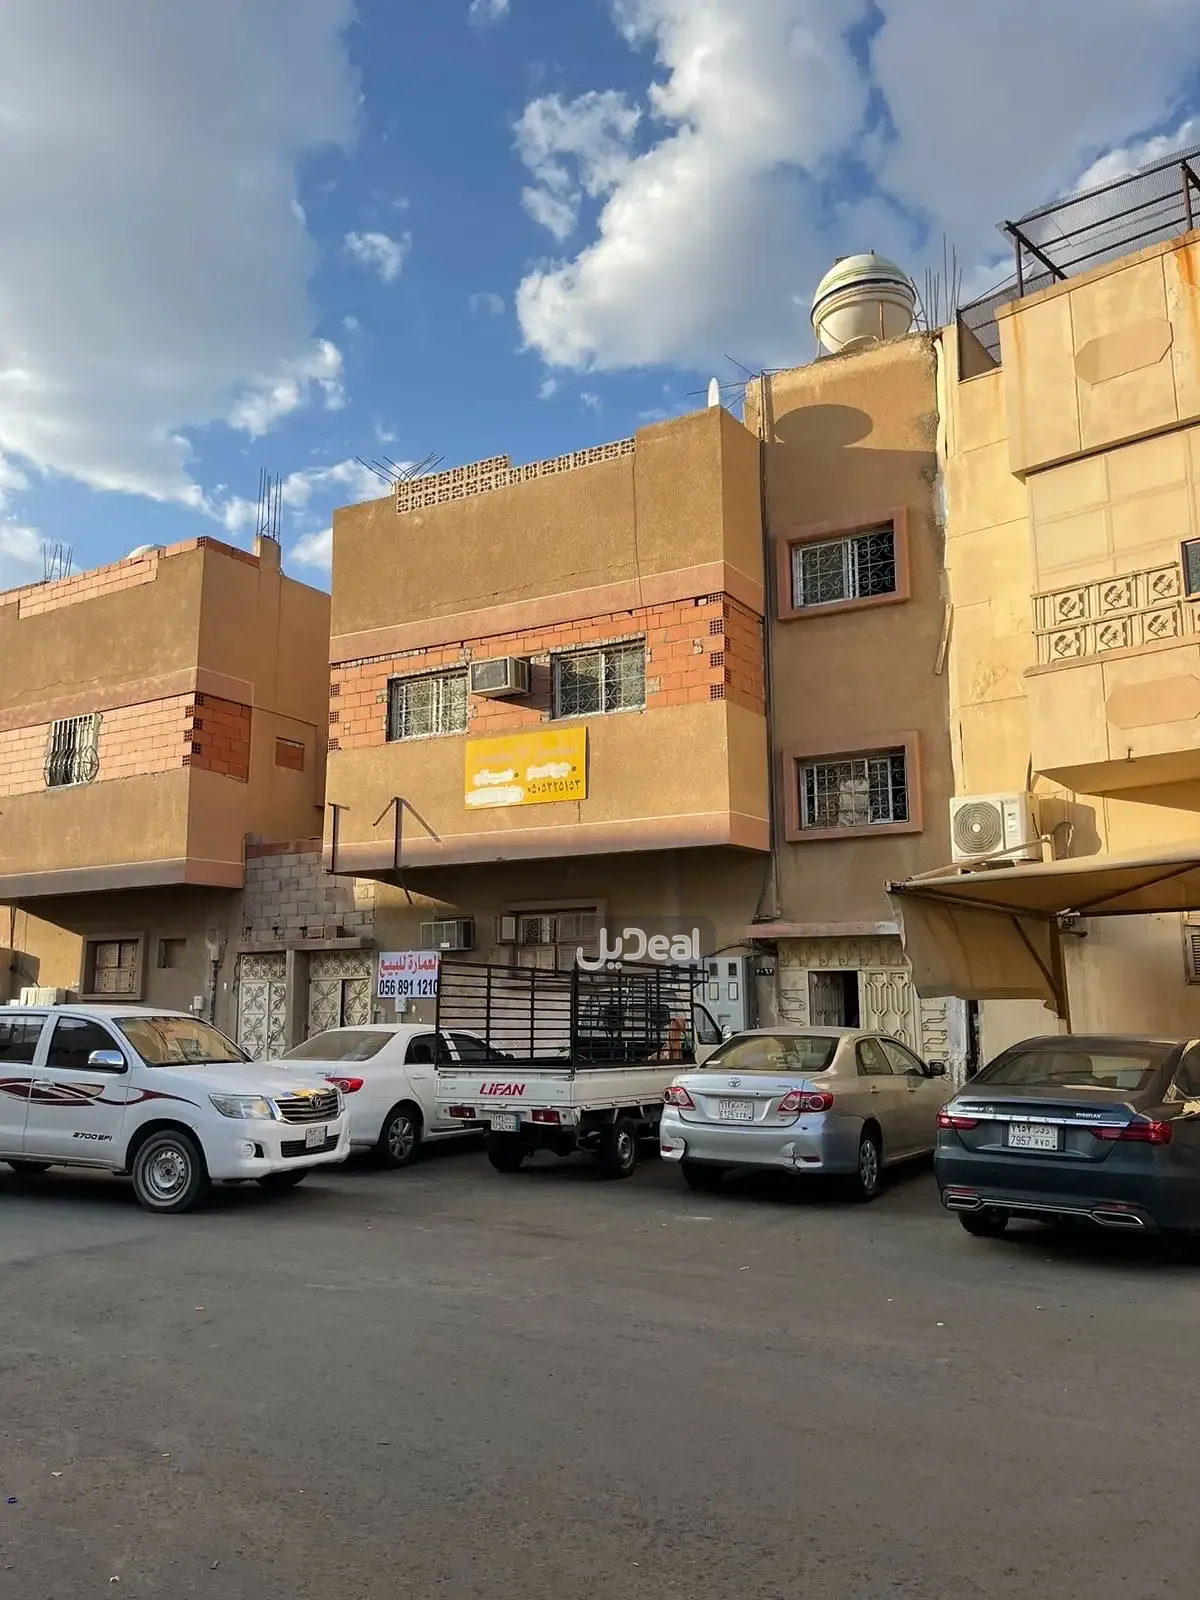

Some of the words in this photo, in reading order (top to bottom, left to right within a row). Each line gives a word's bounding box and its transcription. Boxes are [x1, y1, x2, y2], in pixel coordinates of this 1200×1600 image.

[380, 955, 406, 978] للبيع
[380, 979, 396, 996] 056
[397, 979, 414, 996] 891
[417, 979, 438, 996] 1210
[1011, 1135, 1032, 1147] 7957
